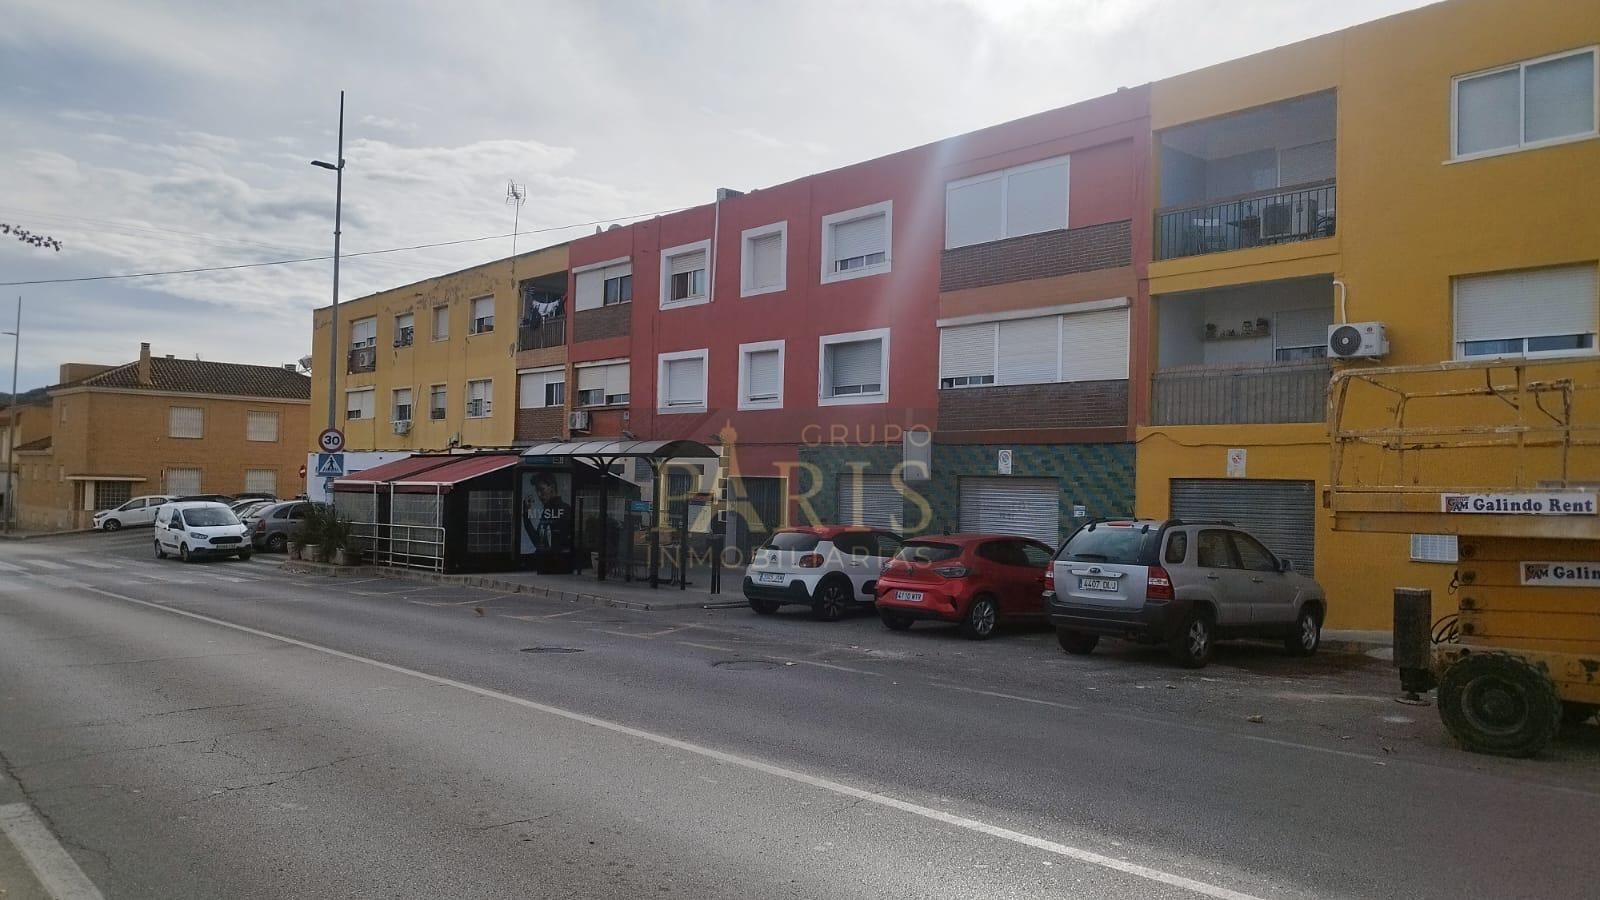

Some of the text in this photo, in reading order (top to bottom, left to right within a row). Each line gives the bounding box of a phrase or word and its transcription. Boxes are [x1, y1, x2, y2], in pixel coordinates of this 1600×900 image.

[324, 435, 340, 446] 30
[1473, 498, 1542, 512] Galindo
[1549, 499, 1592, 512] Rent
[527, 508, 565, 519] MYSLF
